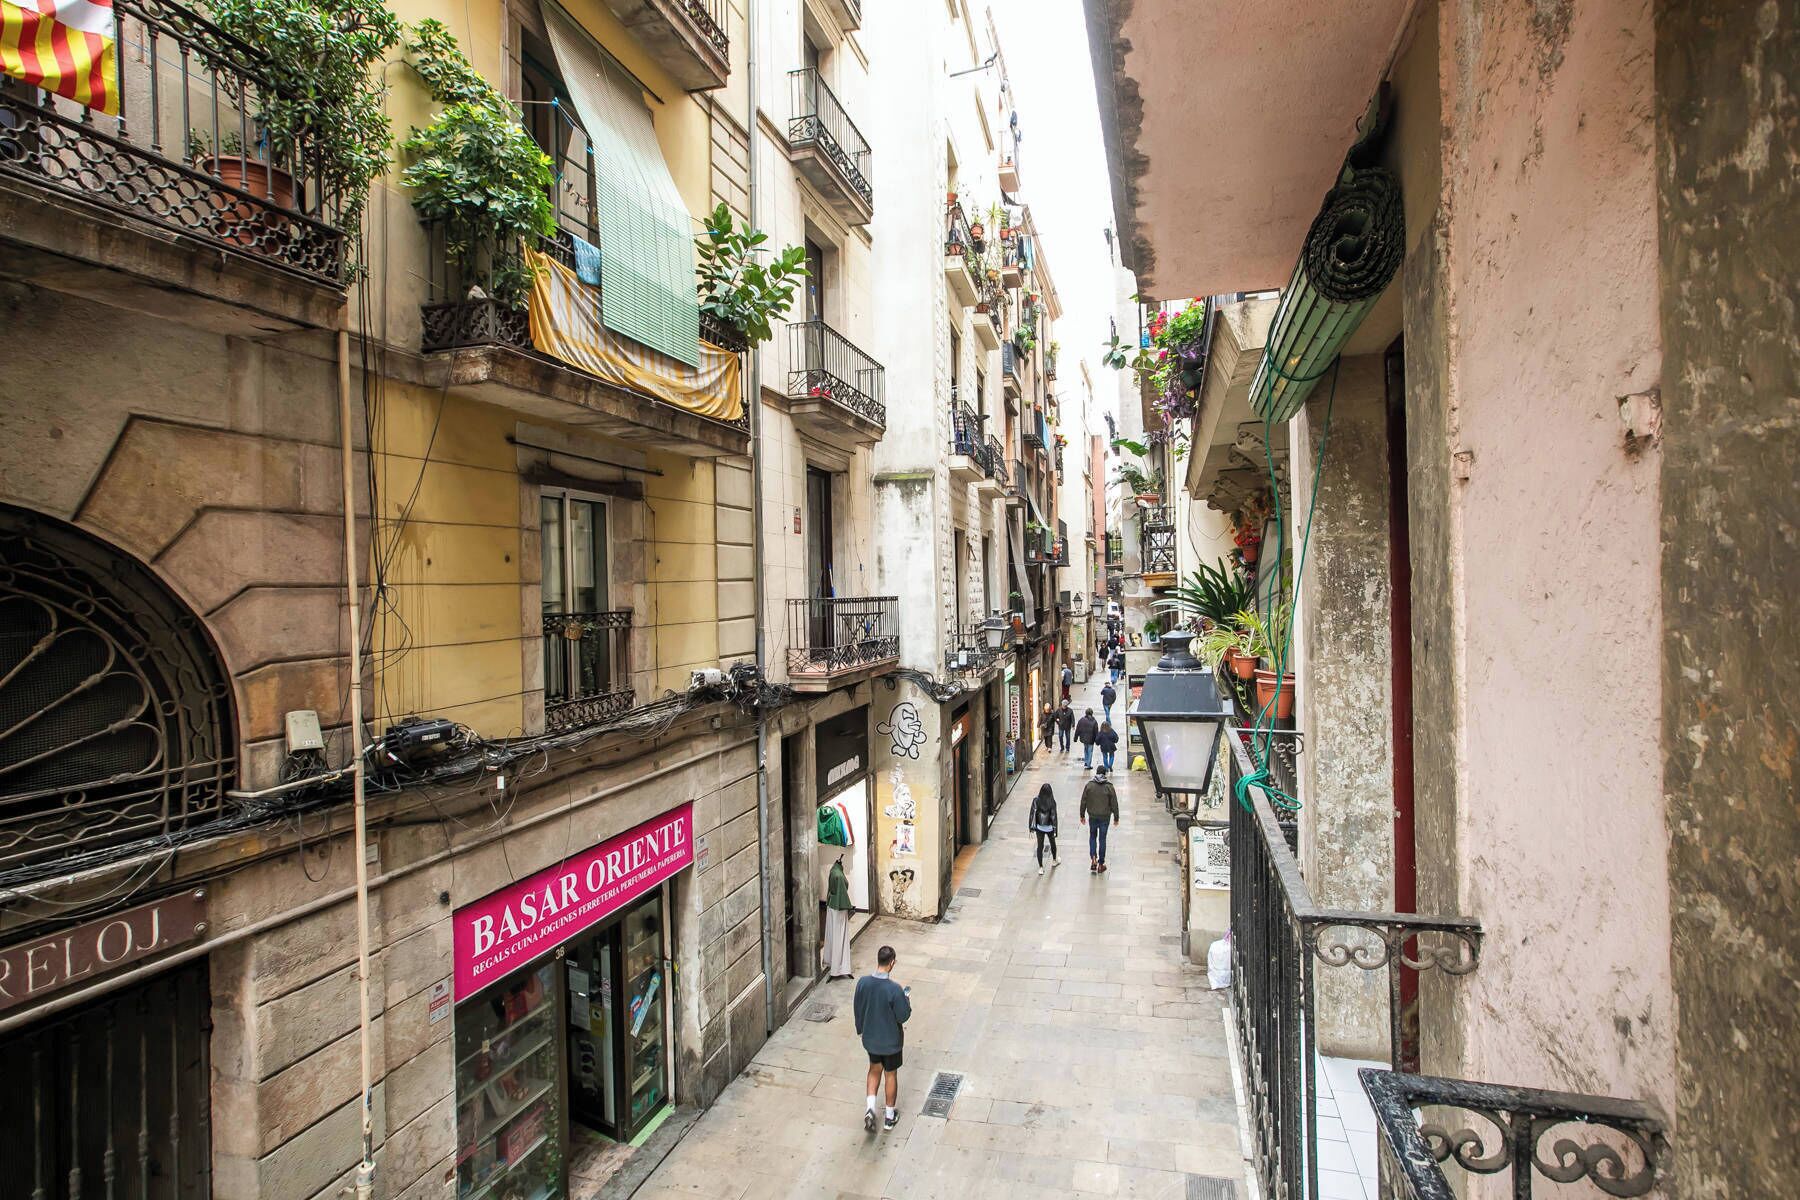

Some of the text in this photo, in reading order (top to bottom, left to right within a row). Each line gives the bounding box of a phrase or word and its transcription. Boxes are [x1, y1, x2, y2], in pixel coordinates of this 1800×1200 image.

[471, 817, 685, 959] BASAR ORIENTE
[472, 947, 510, 977] REGALS
[511, 932, 539, 954] CUINA
[539, 909, 578, 939] JOGUINES
[578, 886, 620, 917] FERRETERIA
[620, 864, 657, 892] PERFUMERIA
[657, 848, 686, 870] PAPERERIA
